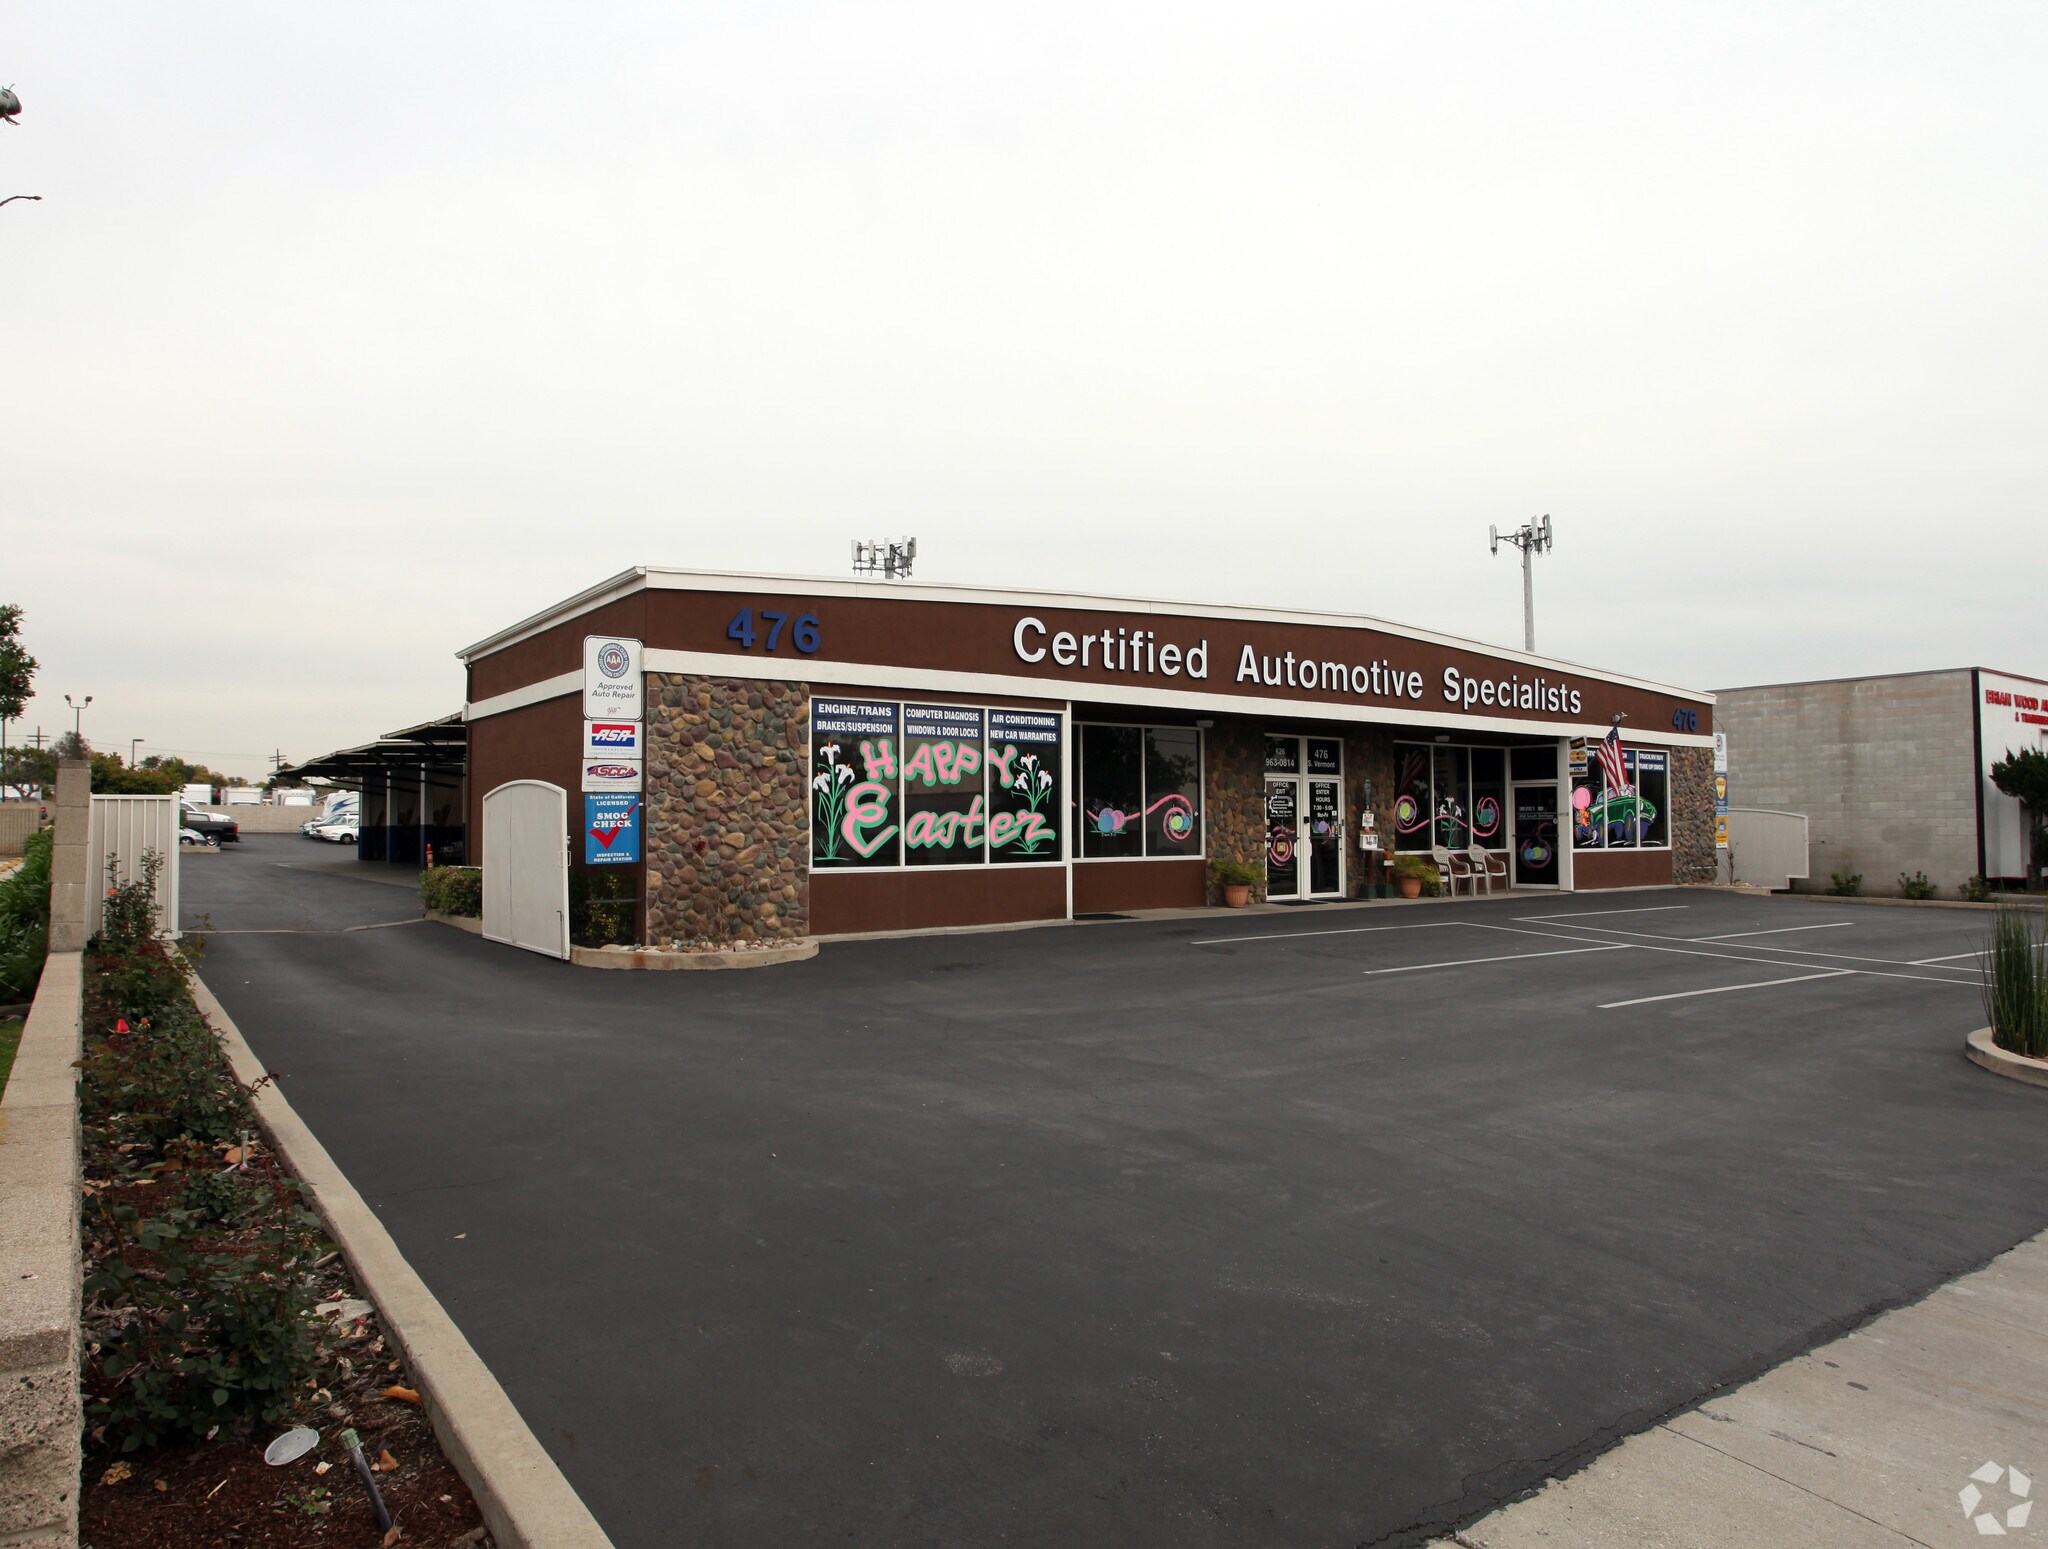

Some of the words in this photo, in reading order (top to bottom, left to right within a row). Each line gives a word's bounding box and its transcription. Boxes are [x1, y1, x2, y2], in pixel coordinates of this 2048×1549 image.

[727, 608, 821, 653] 476
[607, 655, 621, 665] AAA
[1013, 616, 1208, 679] Certified
[1236, 644, 1423, 699] Automotive
[1443, 666, 1582, 714] Specialists
[597, 682, 633, 690] Approved
[612, 691, 635, 700] Repair
[1985, 689, 2012, 706] BRIAN
[2013, 694, 2038, 711] WOOD
[818, 704, 892, 716] ENGINE/TRANS
[906, 708, 943, 719] COMPUTER
[944, 711, 979, 722] DIAGNOSIS
[992, 714, 1004, 723] AIR
[1005, 715, 1055, 726] CONDITIONING
[1672, 708, 1697, 732] 476
[817, 720, 893, 733] BRAKES/SUSPENSION
[907, 725, 936, 735] WINDOWS
[937, 727, 941, 735] &
[942, 727, 959, 736] DOOR
[960, 728, 979, 737] LOCKS
[595, 729, 632, 742] ASA
[990, 730, 1004, 739] NEW
[1005, 730, 1018, 740] CAR
[1019, 731, 1056, 742] WARRANTIES
[1314, 750, 1328, 759] 476
[859, 738, 1018, 788] HAPPY
[1265, 758, 1295, 767] 963-0814
[587, 767, 636, 777] ASCCA
[596, 812, 629, 820] SMOG
[841, 781, 1056, 859] Easter
[593, 820, 632, 828] CHECK
